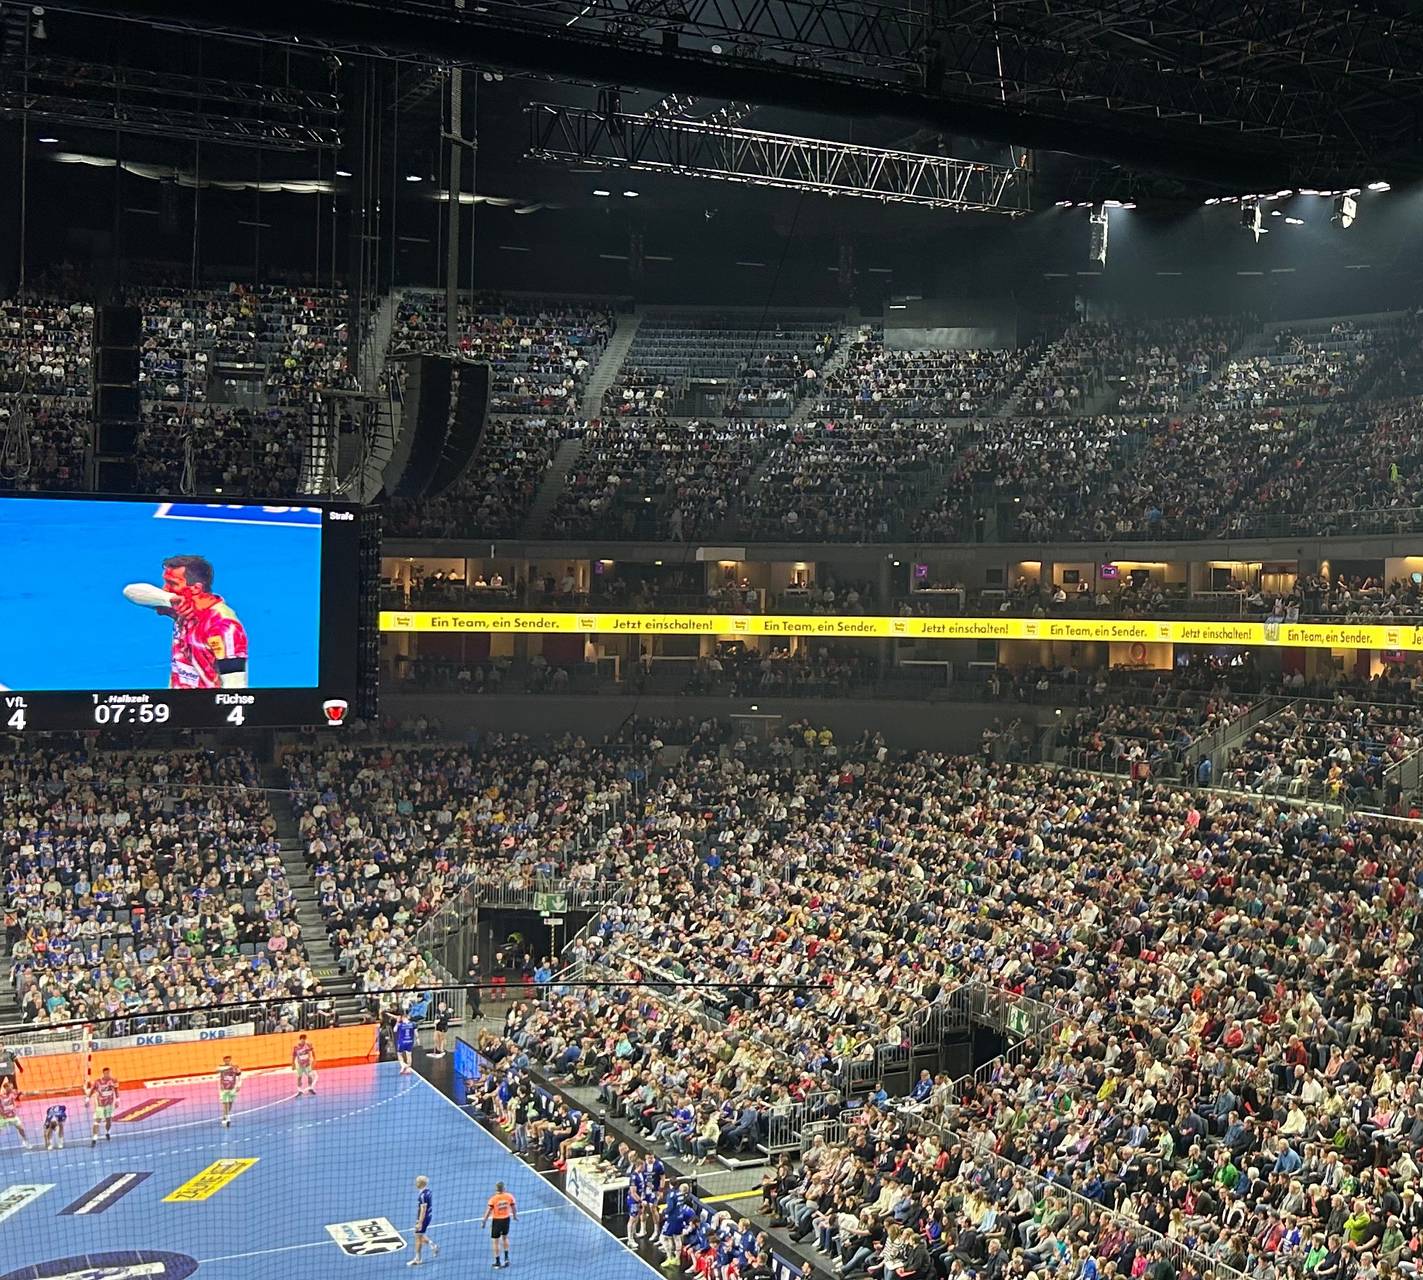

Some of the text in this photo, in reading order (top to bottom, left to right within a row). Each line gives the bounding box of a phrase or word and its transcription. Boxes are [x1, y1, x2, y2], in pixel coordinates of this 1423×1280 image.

[329, 511, 354, 521] Strafe
[431, 616, 560, 629] Ein Team, ein Sender.
[613, 618, 713, 630] Jetzt einschalten!
[764, 620, 877, 633] Ein Team, ein Sender.
[921, 622, 1009, 634] Jetzt einschalten!
[1050, 624, 1064, 635] Ein
[1065, 624, 1093, 637] Team,
[1094, 625, 1110, 637] ein
[1111, 625, 1147, 637] Sender.
[1181, 627, 1201, 639] Jetzt
[1202, 627, 1252, 640] einschalten!
[1287, 629, 1301, 641] Ein
[1300, 629, 1324, 644] Team,
[1325, 632, 1339, 643] ein
[1340, 630, 1373, 644] Sender.
[5, 696, 28, 709] VfL
[108, 694, 150, 704] Halbzeit
[215, 694, 255, 705] Füchse
[7, 709, 27, 730] 4
[94, 703, 170, 724] 07:59
[227, 709, 245, 726] 4
[136, 1036, 164, 1046] DKB
[200, 1030, 226, 1040] DKB
[72, 1042, 99, 1052] DB
